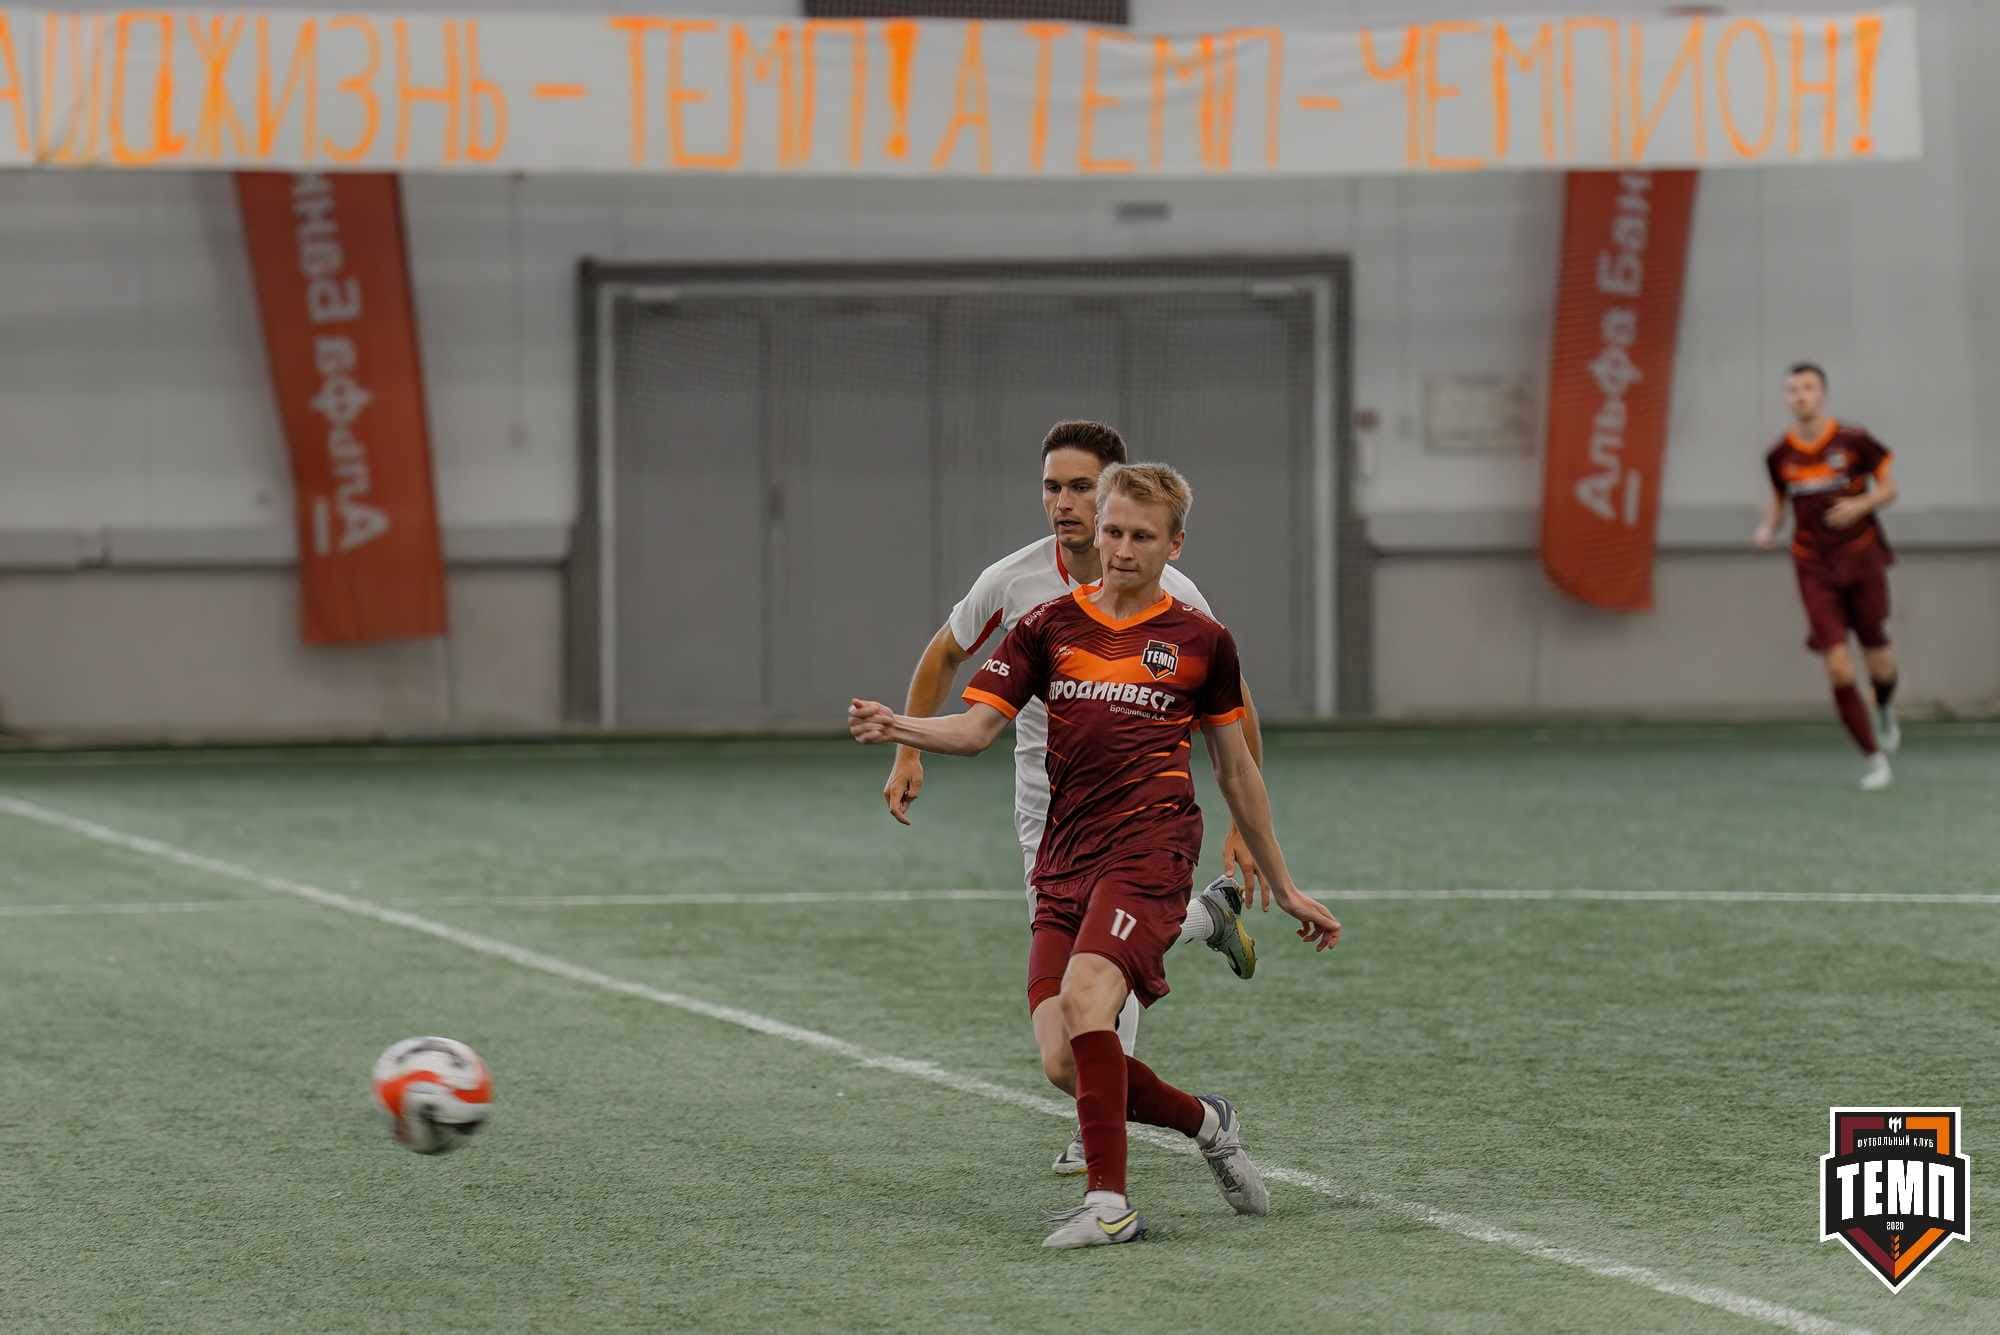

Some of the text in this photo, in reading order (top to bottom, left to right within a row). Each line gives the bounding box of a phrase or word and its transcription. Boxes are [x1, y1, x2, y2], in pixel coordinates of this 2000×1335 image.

[187, 14, 508, 164] ЖИЗНЬ
[1020, 22, 1284, 172] ТЕМП
[1360, 16, 1884, 171] ЧЕМПИОН!
[1573, 308, 1644, 525] Альфа
[1146, 650, 1176, 671] ТЕМП
[1049, 680, 1176, 712] ПРОДИНВЕСТ
[1110, 908, 1137, 941] 17
